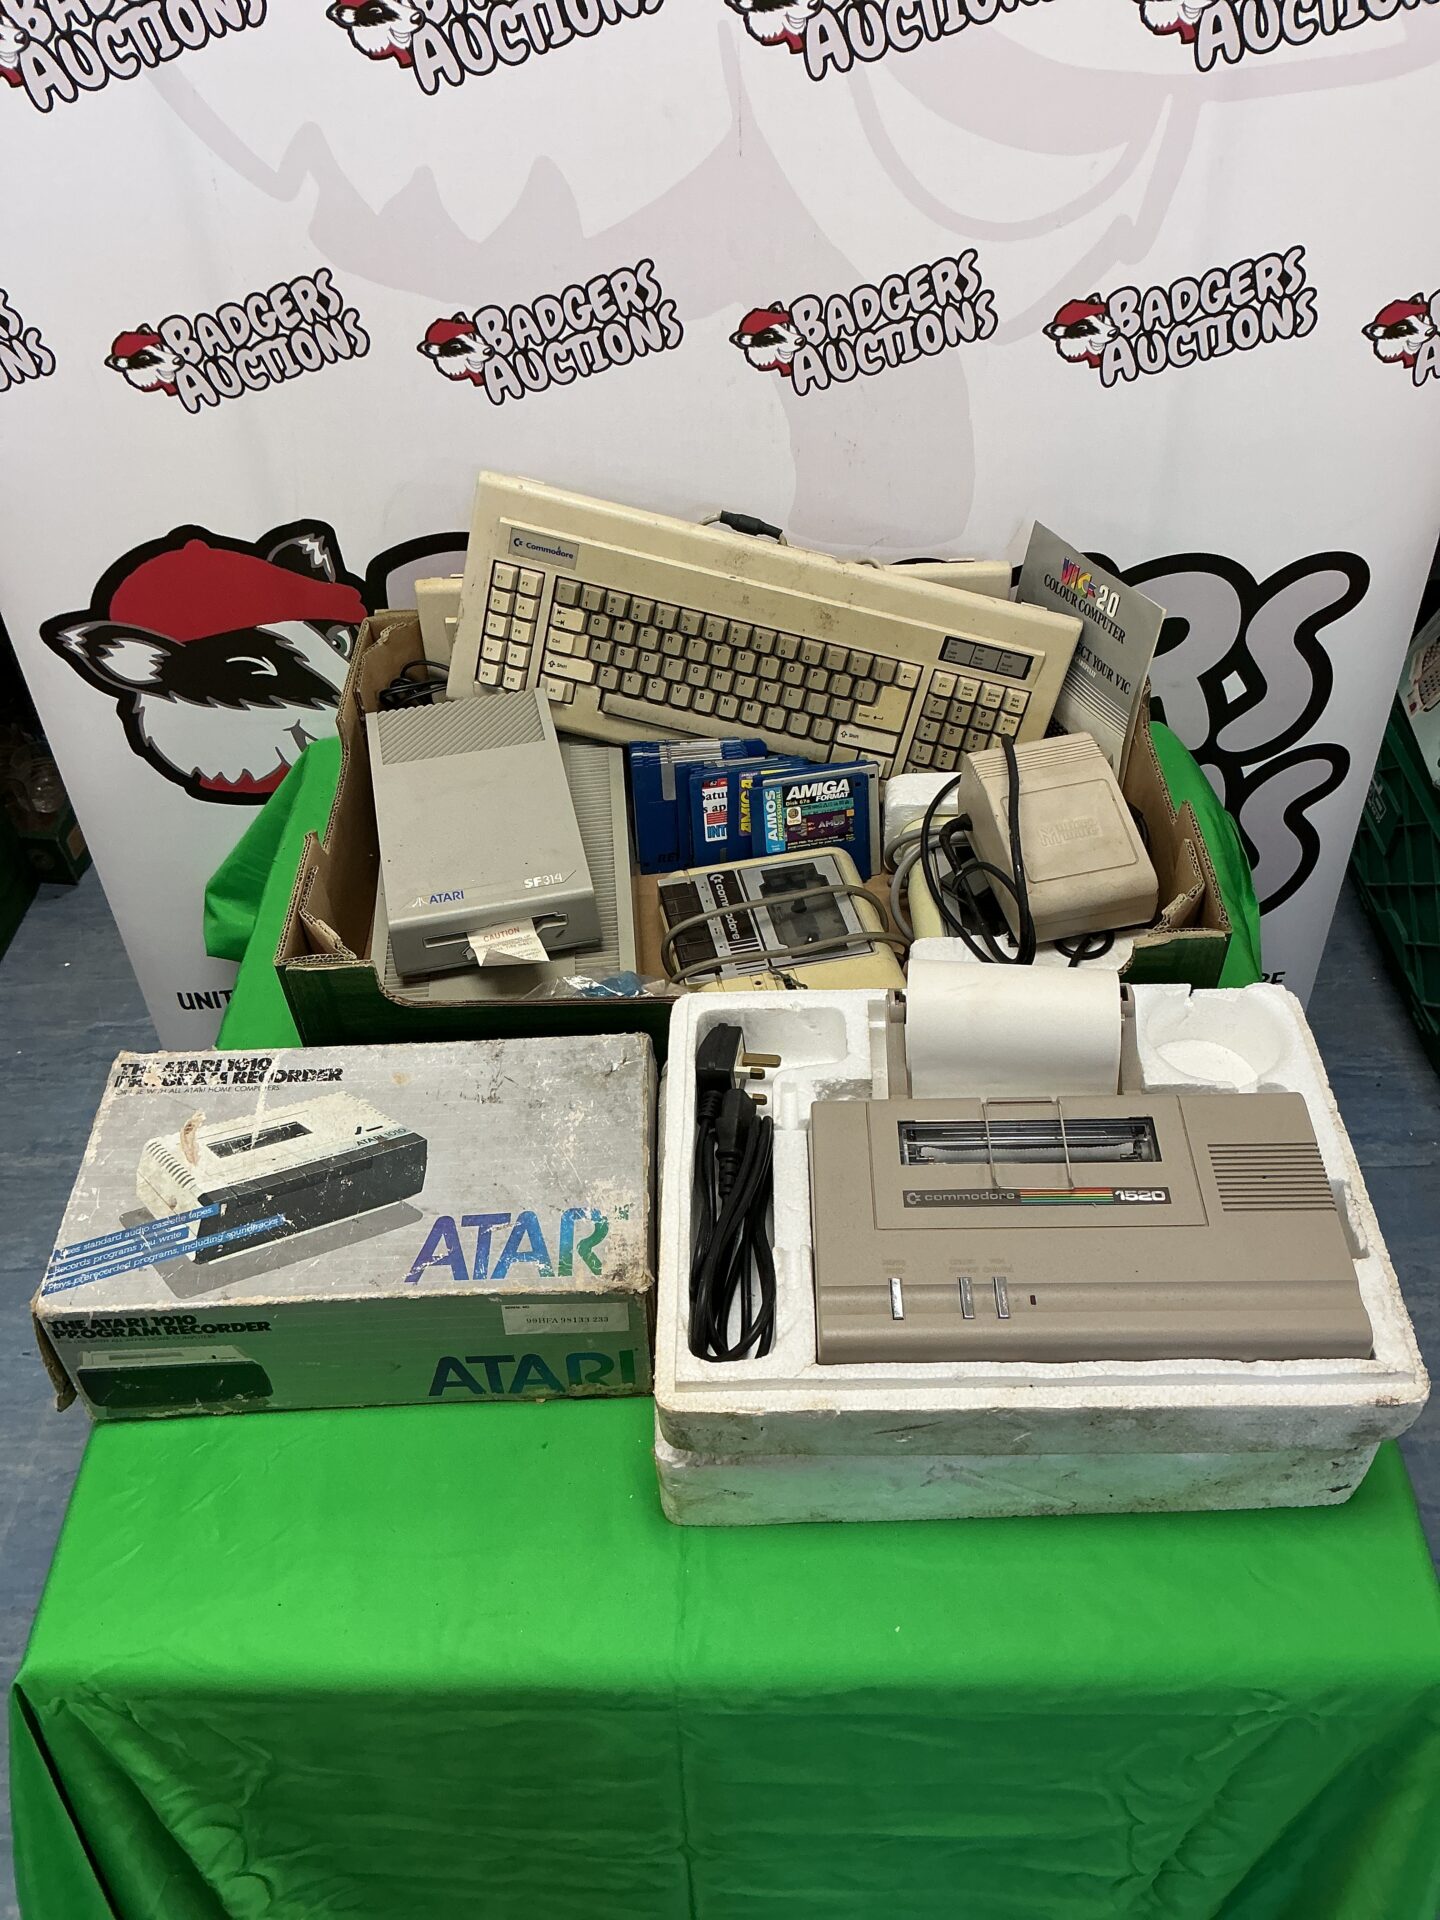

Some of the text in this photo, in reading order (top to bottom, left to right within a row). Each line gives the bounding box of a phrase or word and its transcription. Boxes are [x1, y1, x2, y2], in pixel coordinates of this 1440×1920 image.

[413, 0, 664, 95] AUCTIO
[472, 258, 662, 357] BADGERS
[789, 248, 982, 347] BADGERS
[1107, 245, 1306, 338] BADGERS
[157, 267, 343, 365] BADGERS
[484, 299, 683, 405] AUCTIONS
[791, 289, 998, 396] AUCTIONS
[1100, 287, 1317, 388] AUCTIONS
[176, 308, 370, 413] AUCTIONS
[526, 542, 574, 560] Commodore
[1044, 573, 1126, 645] COLOUR COMPUTER
[651, 681, 657, 689] C
[812, 671, 818, 679] P
[1093, 655, 1114, 682] YOUR
[1116, 673, 1131, 695] VIC
[956, 705, 962, 713] 8
[980, 711, 987, 719] 9
[740, 779, 753, 833] AMIGA
[786, 779, 850, 800] AMIGA
[815, 792, 849, 802] FORMAT
[707, 825, 727, 838] INT
[765, 790, 779, 841] AMOS
[776, 790, 784, 841] PROFESSIONAL
[429, 890, 465, 905] ATARI
[524, 873, 563, 889] SF314
[483, 926, 520, 943] CAUTION
[231, 1067, 344, 1085] RECORDER
[924, 1190, 1166, 1201] commodore 1520
[83, 1233, 123, 1250] standard
[124, 1226, 150, 1238] audio
[404, 1206, 628, 1283] ATAR
[47, 1278, 73, 1292] Plays
[182, 1233, 224, 1250] including
[54, 1258, 91, 1273] Records
[93, 1244, 138, 1264] programs
[140, 1240, 156, 1251] you
[50, 1314, 198, 1331] THE ATARI 1010
[52, 1320, 273, 1339] PROGRAM RECORDER
[429, 1349, 638, 1396] ATARI
